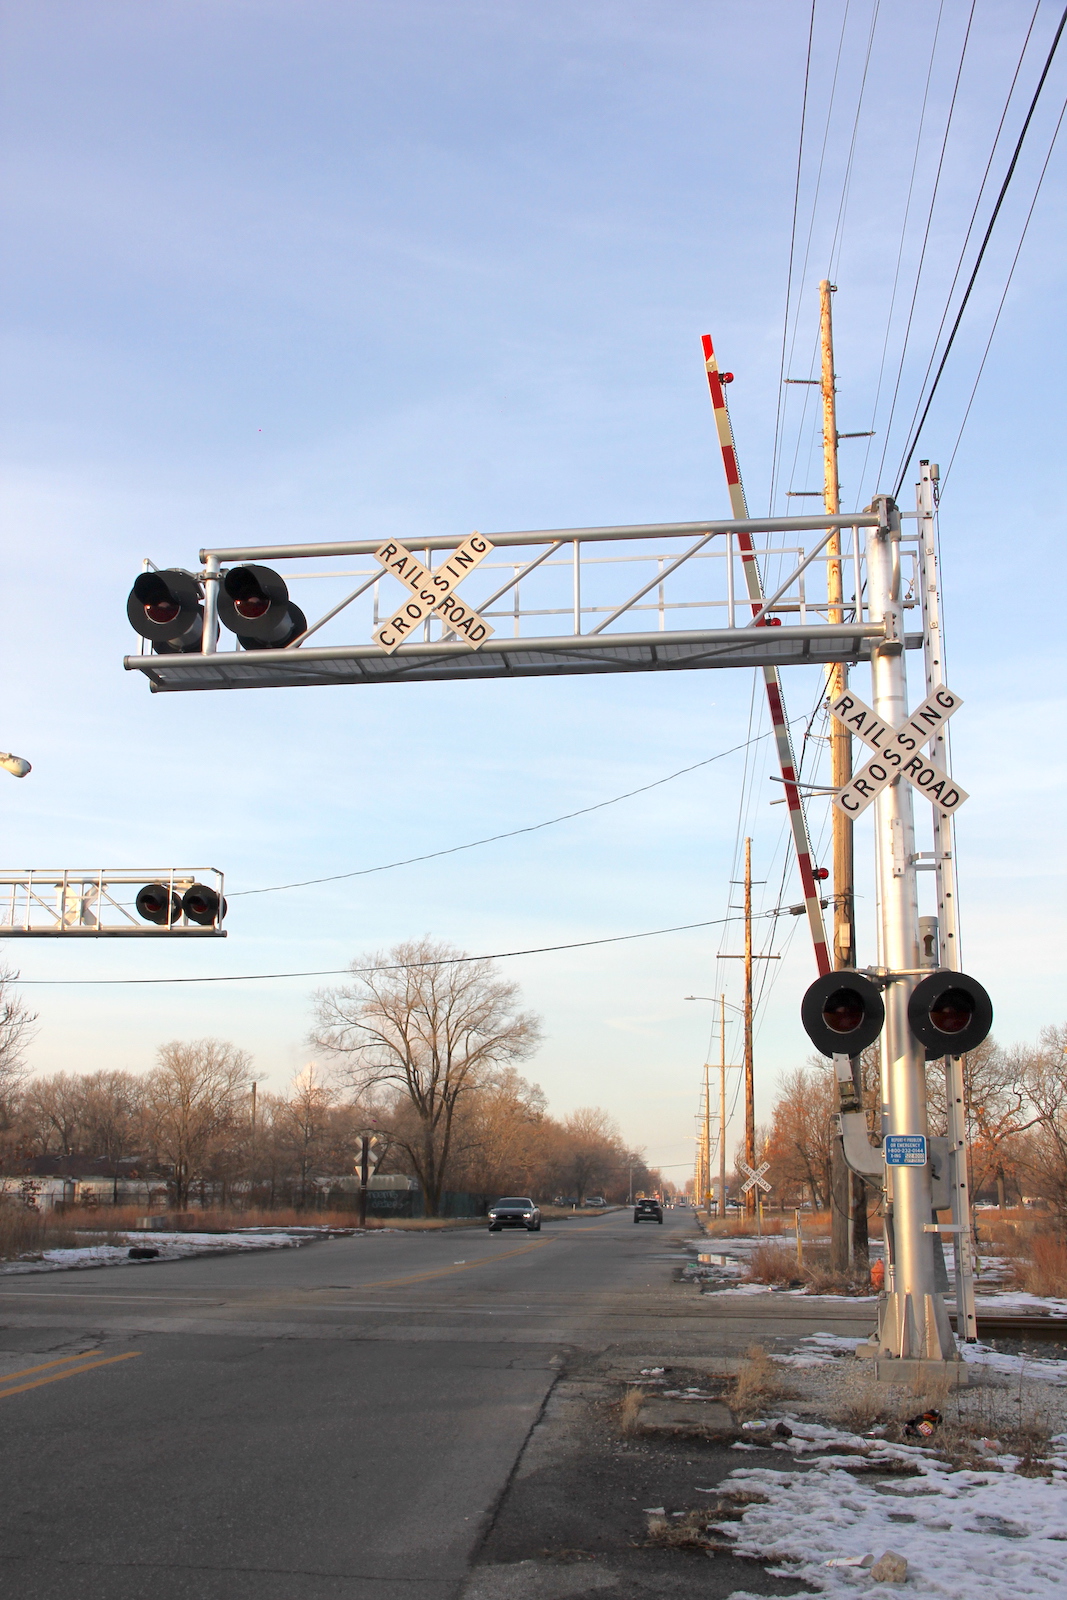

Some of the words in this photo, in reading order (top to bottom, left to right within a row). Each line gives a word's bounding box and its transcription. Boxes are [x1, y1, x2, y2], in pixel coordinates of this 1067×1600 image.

[379, 537, 486, 646] CROSSING
[840, 691, 955, 811] CROSSING
[743, 1164, 768, 1191] CROSSING
